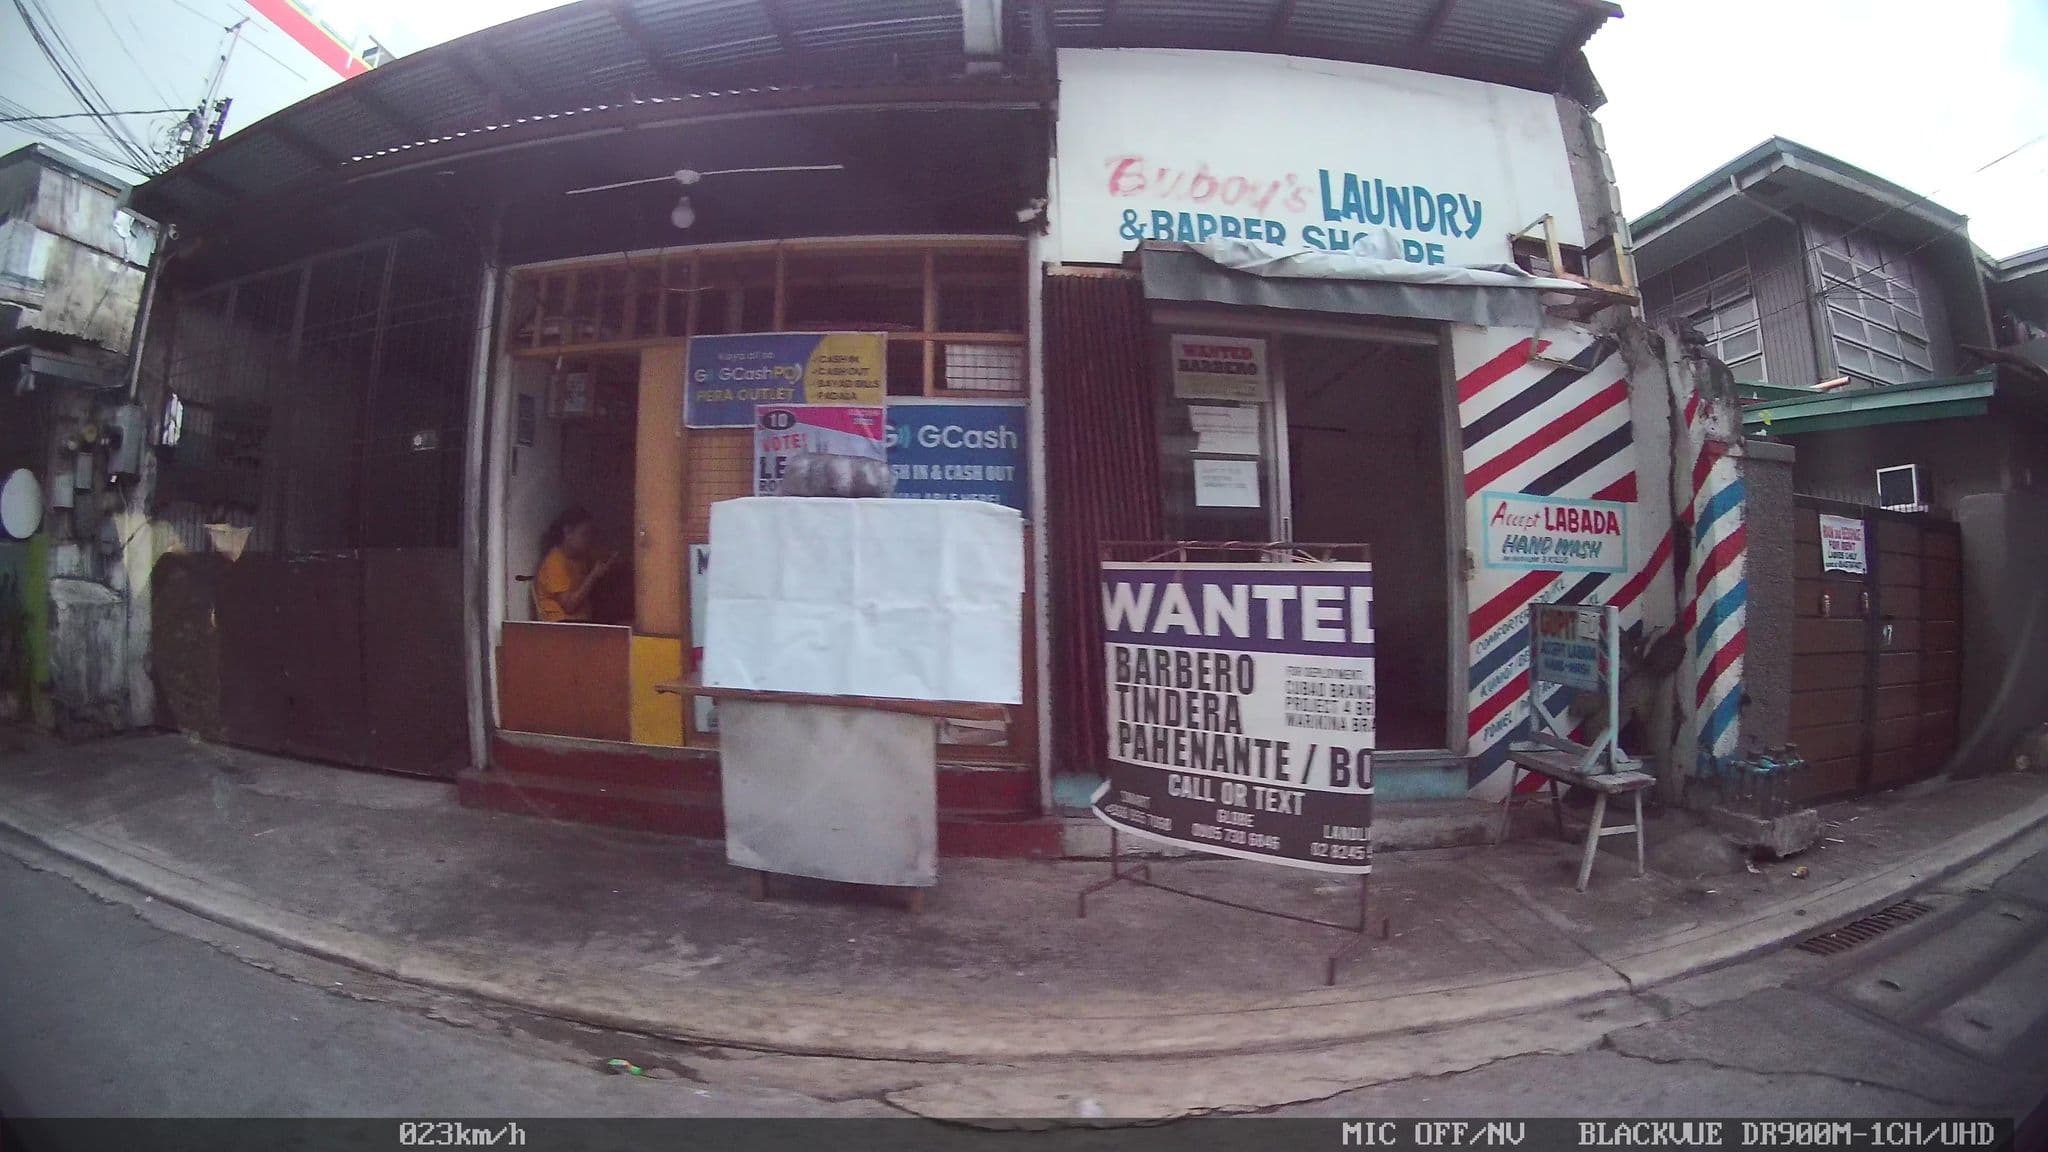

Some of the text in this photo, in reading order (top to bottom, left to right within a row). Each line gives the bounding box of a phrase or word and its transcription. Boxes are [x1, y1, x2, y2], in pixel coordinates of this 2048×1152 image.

[1319, 169, 1482, 240] LAUNDRY
[1119, 208, 1148, 240] &
[1302, 225, 1445, 265] SHPE
[917, 424, 1018, 449] GCash
[944, 465, 983, 481] CASH
[985, 466, 1016, 481] OUT
[1544, 506, 1620, 536] LABADA
[1502, 534, 1602, 559] HAND WASH
[1115, 646, 1254, 695] BARBERO
[1285, 680, 1326, 697] CUBAO
[1285, 696, 1339, 714] PROJECT
[1115, 683, 1243, 734] TINDERA
[1116, 720, 1290, 782] PAHENANTE
[1302, 743, 1317, 784] /
[1168, 774, 1216, 802] CALL
[1221, 781, 1248, 807] OR
[1253, 786, 1306, 815] TEXT
